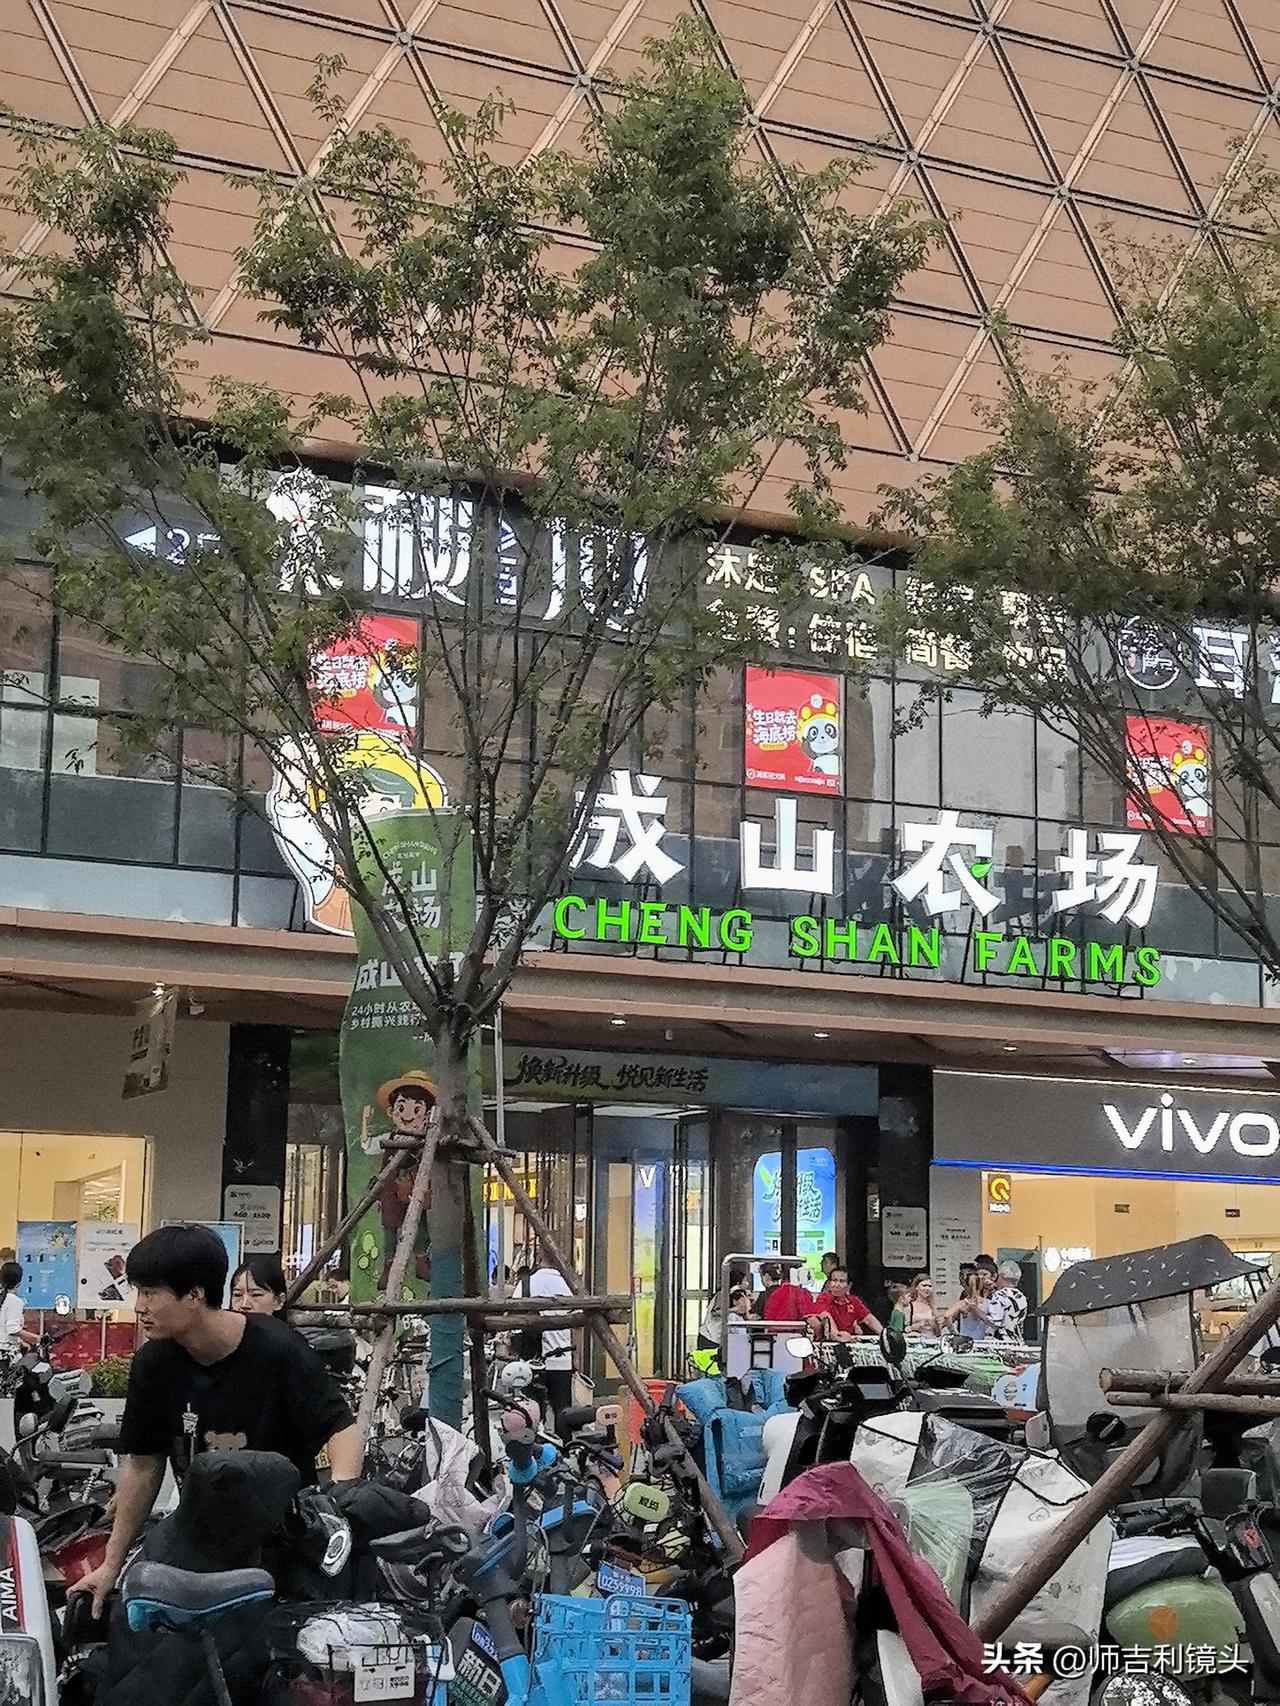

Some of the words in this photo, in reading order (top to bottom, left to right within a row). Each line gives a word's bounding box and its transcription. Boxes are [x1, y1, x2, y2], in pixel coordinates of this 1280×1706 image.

[809, 566, 876, 605] SPA
[752, 724, 796, 744] 海底捞
[568, 769, 1159, 928] 成山农场
[554, 895, 754, 953] CHENG
[791, 915, 940, 968] SHAN
[974, 931, 1161, 987] FARMS
[1103, 1092, 1279, 1157] vivo
[0, 1567, 18, 1621] AIMA
